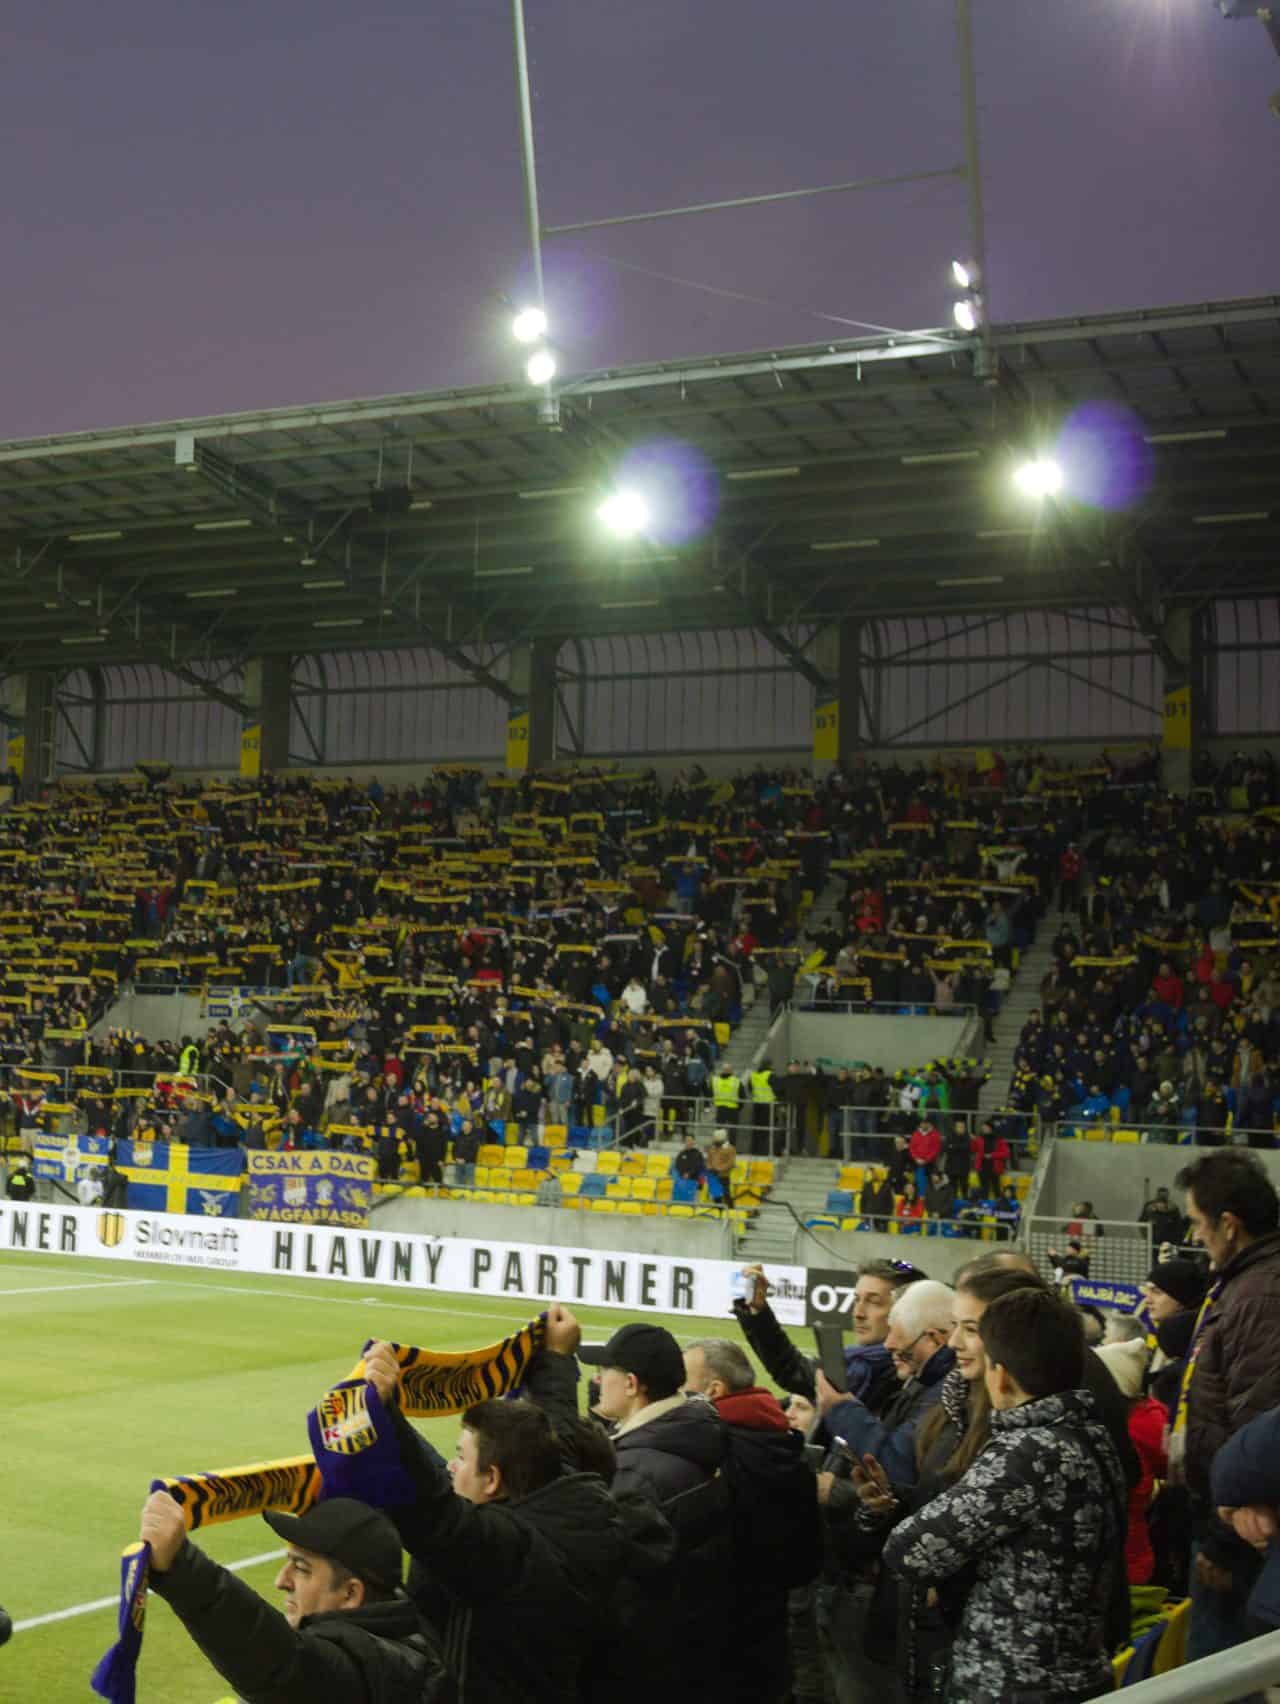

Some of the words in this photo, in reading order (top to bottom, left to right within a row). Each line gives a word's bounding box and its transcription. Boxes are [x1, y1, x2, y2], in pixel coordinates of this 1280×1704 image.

[253, 1155, 302, 1170] CSAK
[310, 1156, 322, 1170] A
[329, 1157, 369, 1175] DAC
[135, 1219, 239, 1252] Slovnaft
[472, 1248, 694, 1310] PARTNER
